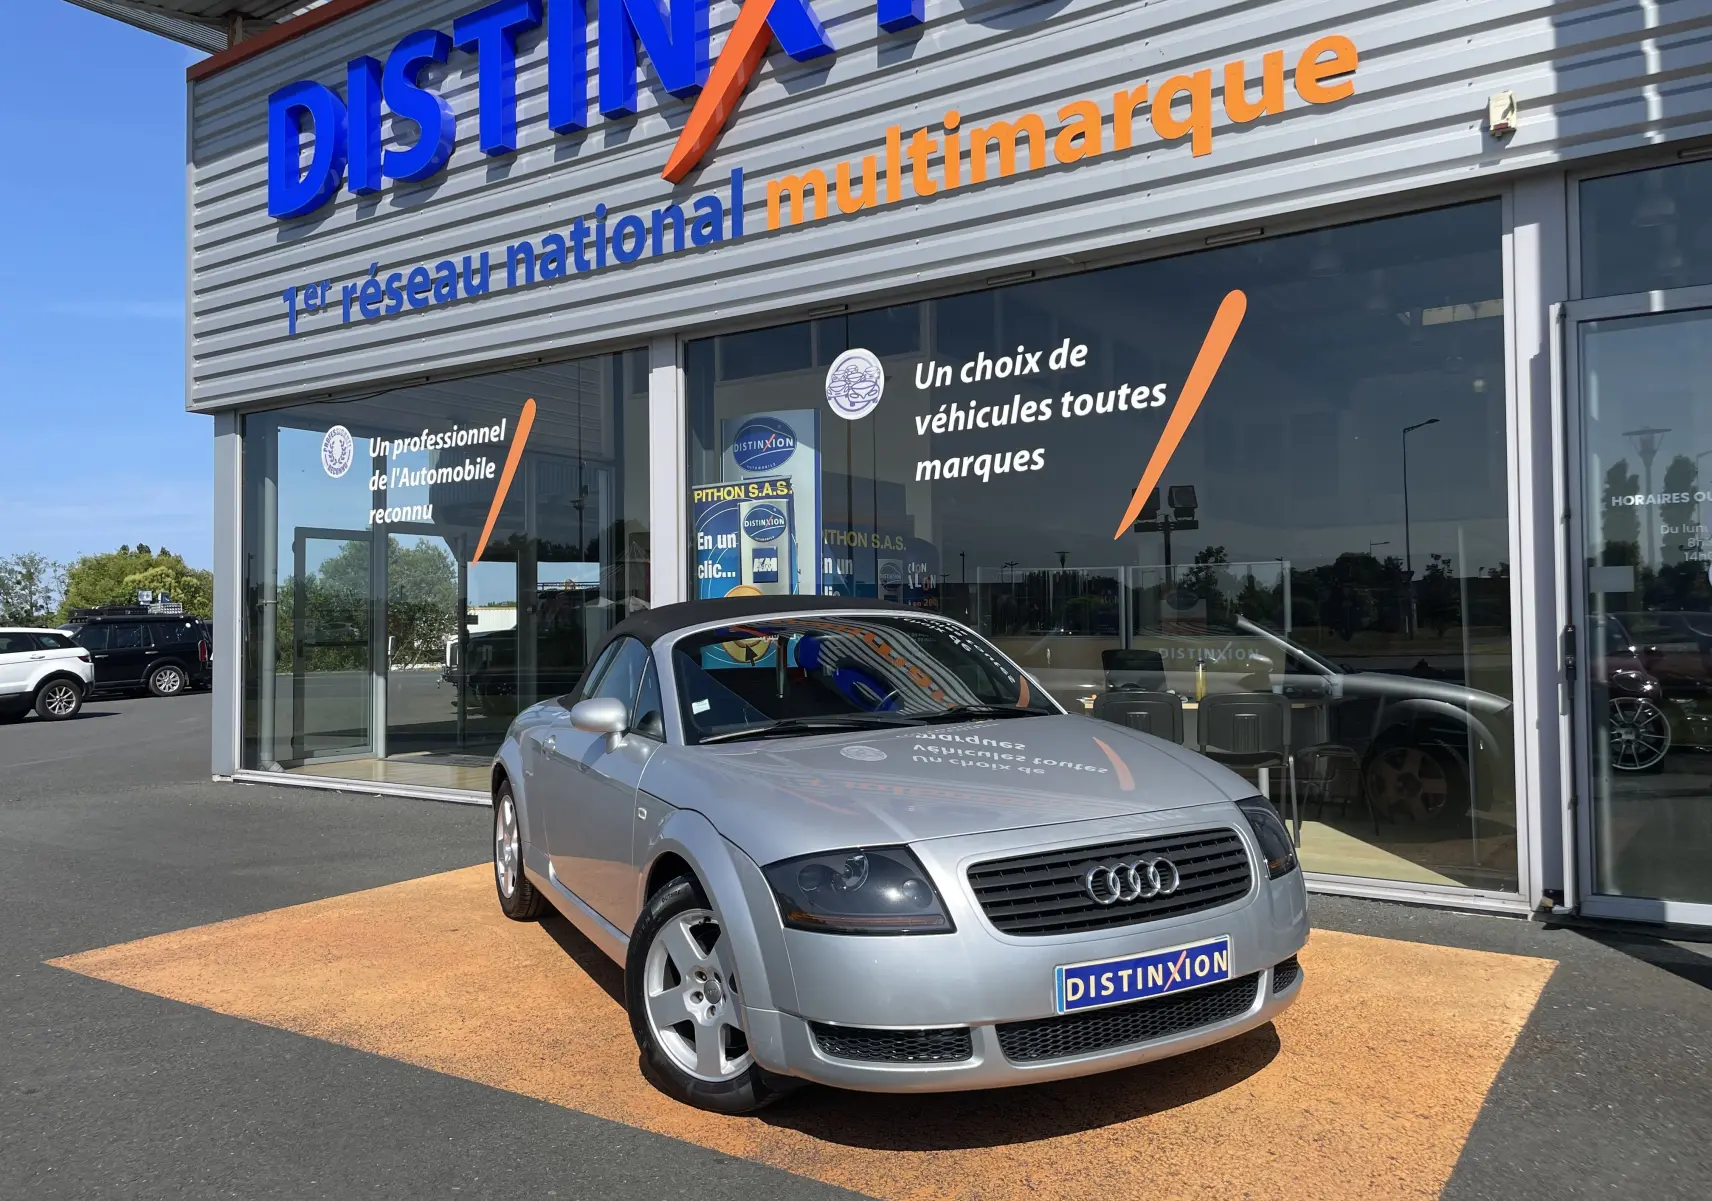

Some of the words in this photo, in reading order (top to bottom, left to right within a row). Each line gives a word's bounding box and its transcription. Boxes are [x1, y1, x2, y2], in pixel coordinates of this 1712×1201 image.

[282, 278, 332, 335] 1er
[341, 250, 490, 323] réseau
[506, 167, 744, 288] national
[766, 34, 1359, 230] multimarque
[914, 360, 952, 390] Un
[960, 345, 1044, 384] choix
[1049, 337, 1089, 371] de
[915, 393, 1052, 436] véhicules
[1061, 383, 1168, 418] toutes
[369, 437, 390, 458] Un
[392, 418, 507, 460] professionnel
[734, 433, 795, 453] DISTINXION
[369, 473, 387, 491] de
[391, 456, 496, 489] l'Automobile
[915, 447, 1046, 483] marques
[694, 485, 745, 503] PITHON
[748, 480, 793, 498] S.A.S.
[1611, 492, 1690, 506] HORAIRES
[369, 504, 433, 525] reconnu
[744, 516, 785, 527] DISTINXION
[1660, 524, 1679, 535] Du
[697, 531, 713, 550] En
[717, 533, 737, 549] un
[871, 533, 907, 551] S.A.S.
[697, 560, 737, 579] clic...
[753, 557, 778, 573] KM
[822, 557, 833, 574] n
[836, 558, 854, 575] un
[1158, 641, 1260, 664] DISTINXION
[1066, 949, 1228, 1002] DISTINXION
